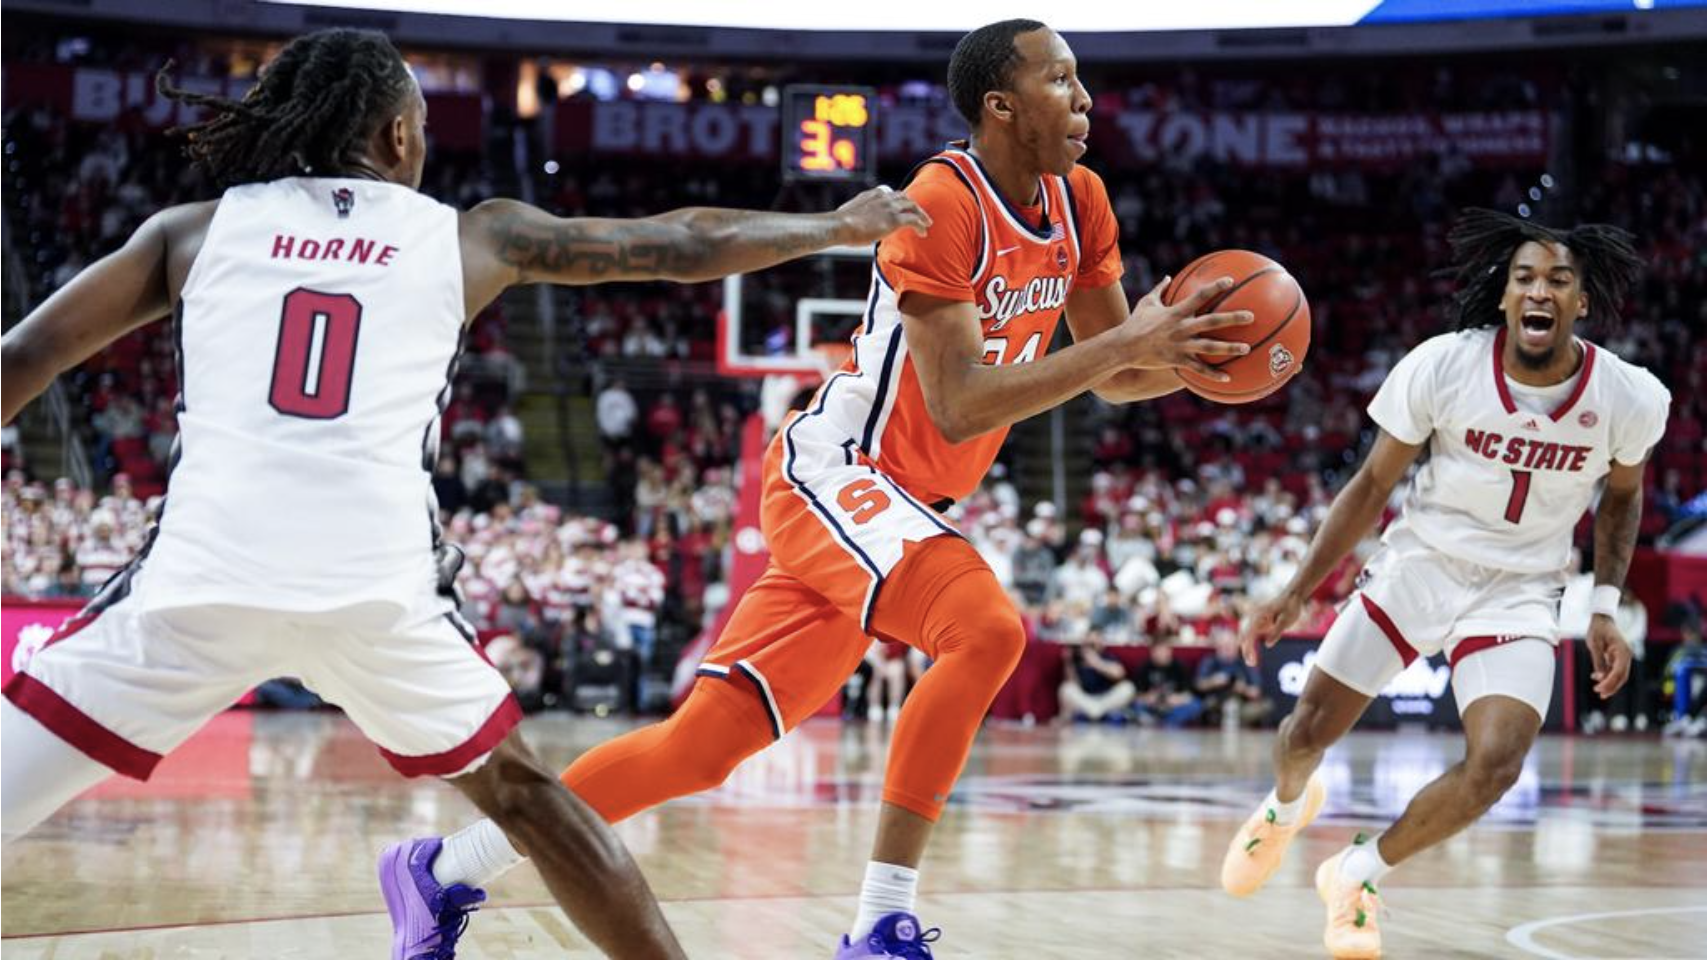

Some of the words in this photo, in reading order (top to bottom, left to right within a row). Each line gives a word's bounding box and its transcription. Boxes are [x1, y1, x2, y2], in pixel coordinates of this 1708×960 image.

[592, 102, 966, 153] BROTRS
[271, 235, 399, 266] HORNE
[268, 286, 363, 420] 0
[1465, 428, 1503, 459] NC
[1502, 437, 1594, 472] STATE
[836, 478, 892, 525] S
[1504, 470, 1532, 525] 1
